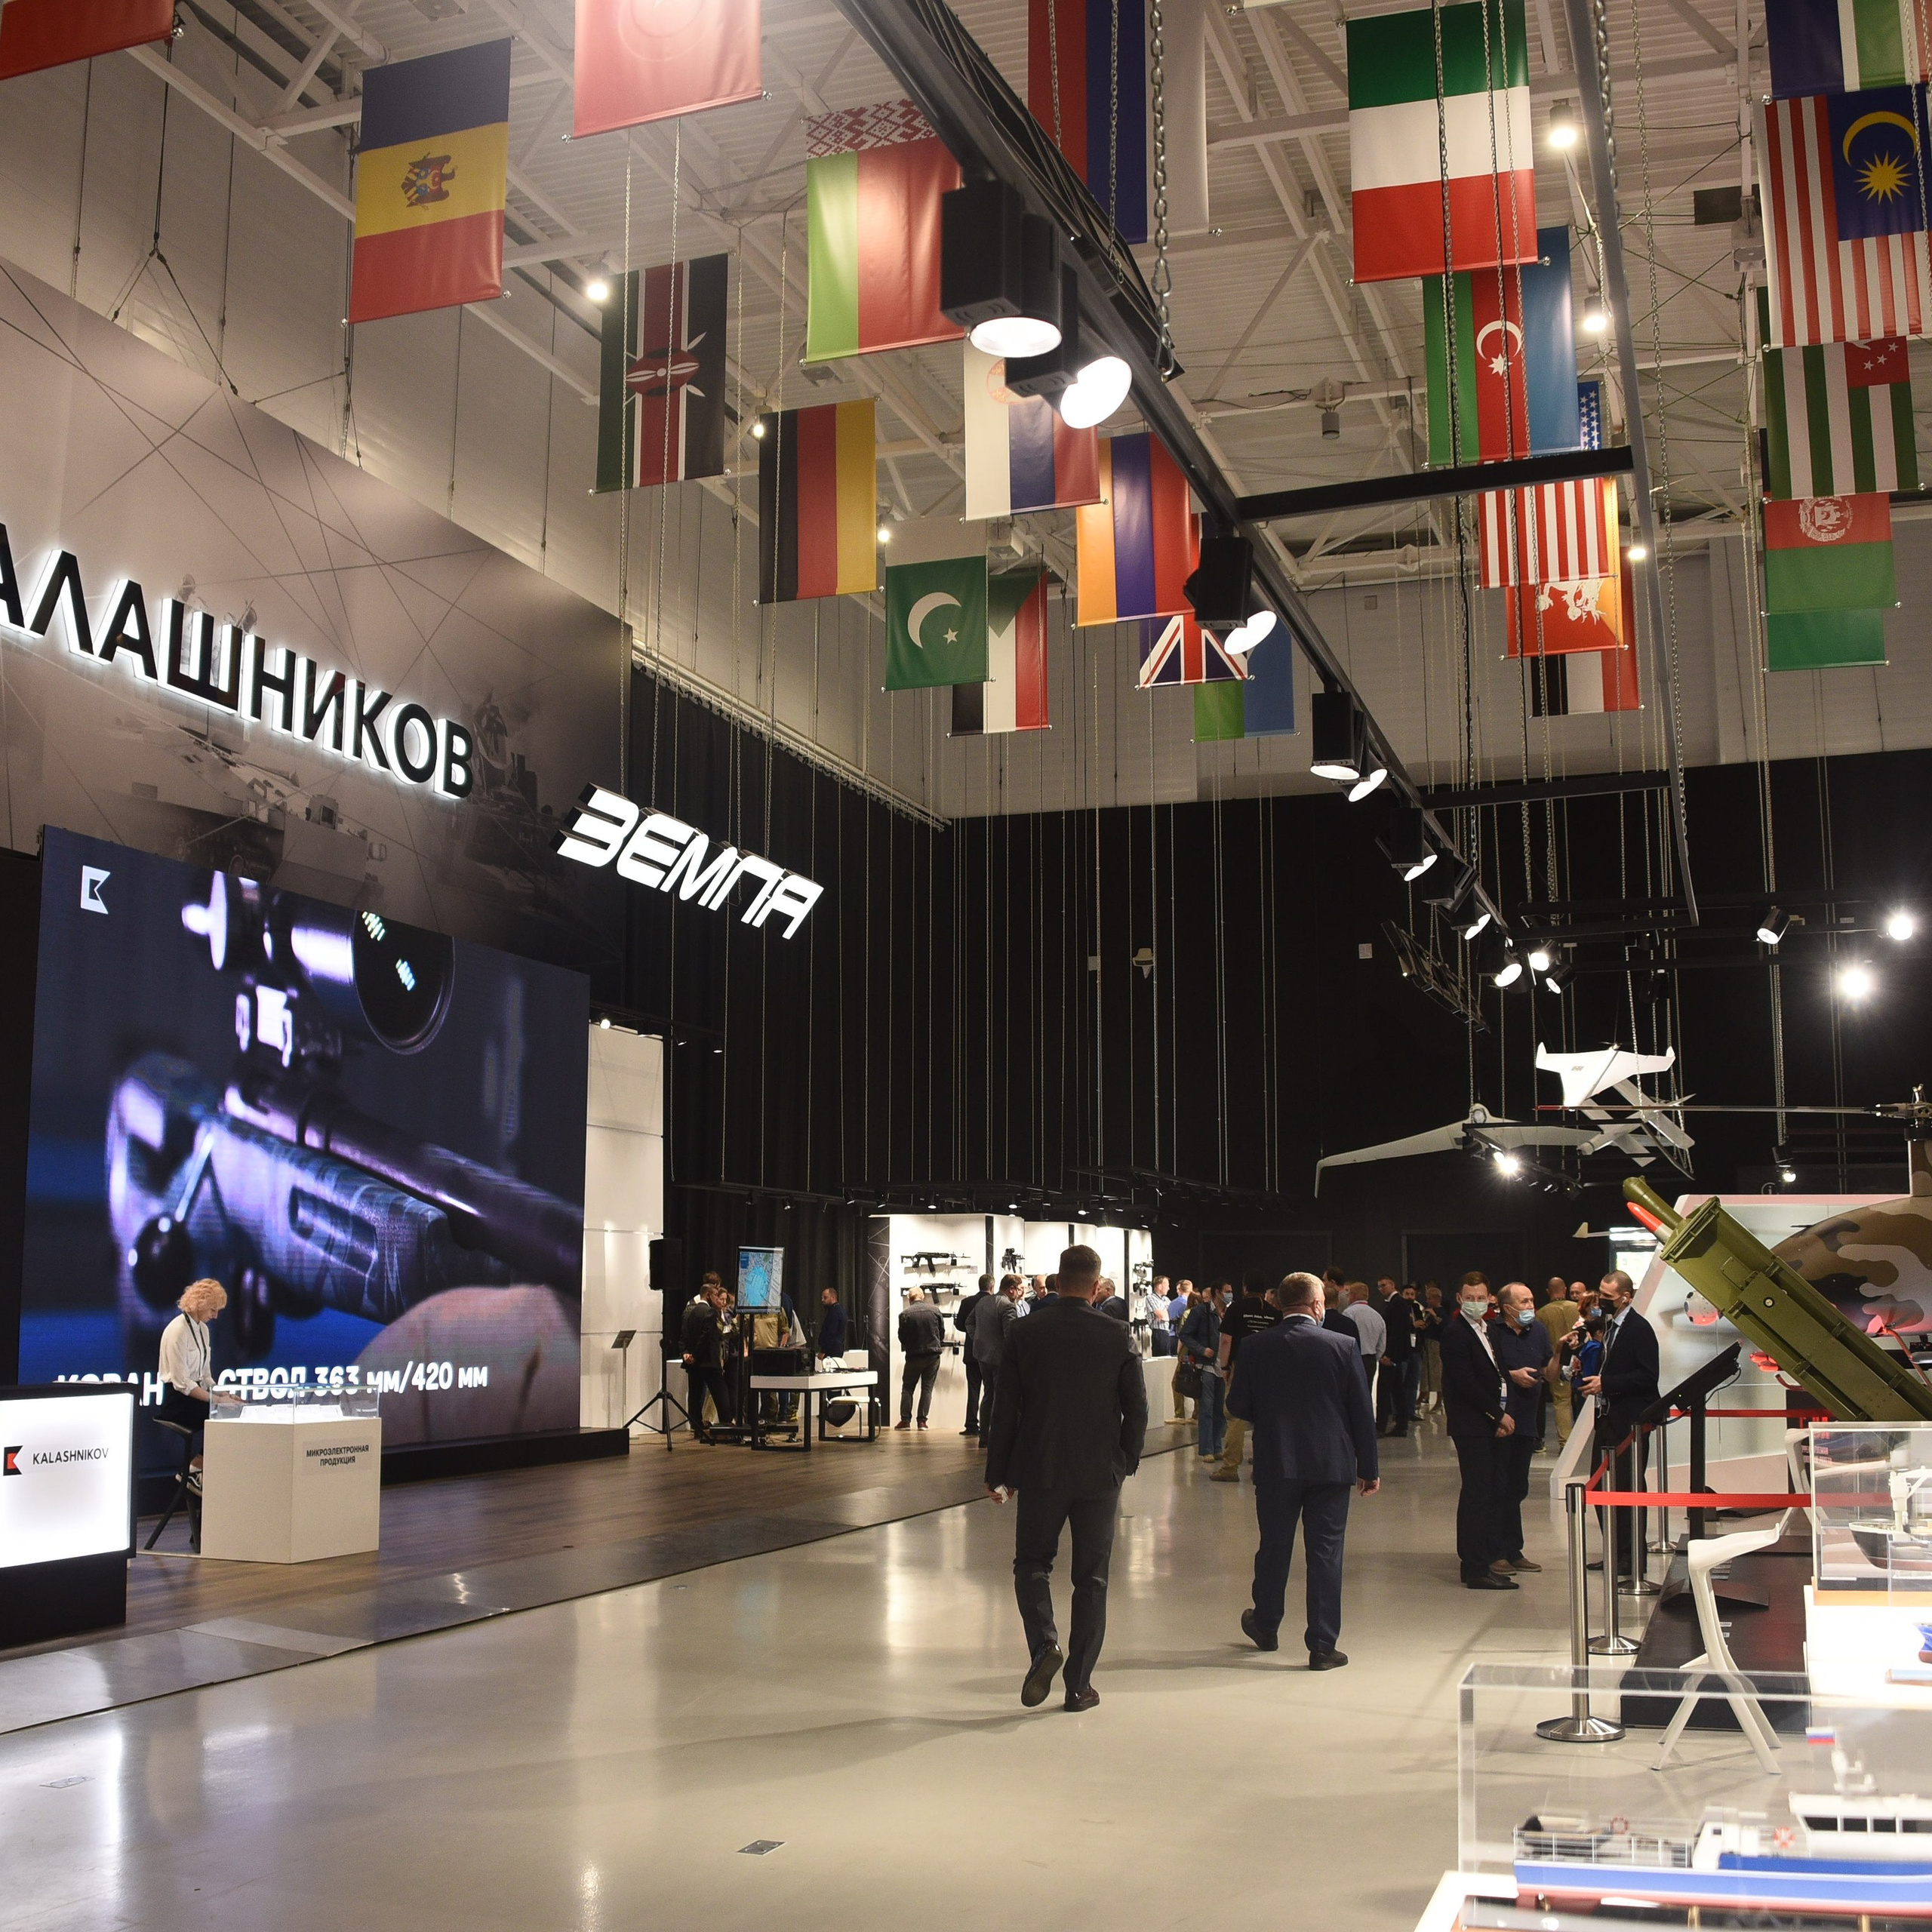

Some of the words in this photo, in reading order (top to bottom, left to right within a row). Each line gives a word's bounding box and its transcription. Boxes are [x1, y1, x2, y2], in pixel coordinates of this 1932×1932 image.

[217, 1367, 306, 1401] СТВОЛ
[314, 1366, 359, 1397] 363
[32, 1447, 109, 1466] KALASHNIKOV
[306, 1444, 370, 1458] МИКРОЭЛЕКТРОННАЯ
[319, 1456, 356, 1466] ПРОДУКЦИЯ
